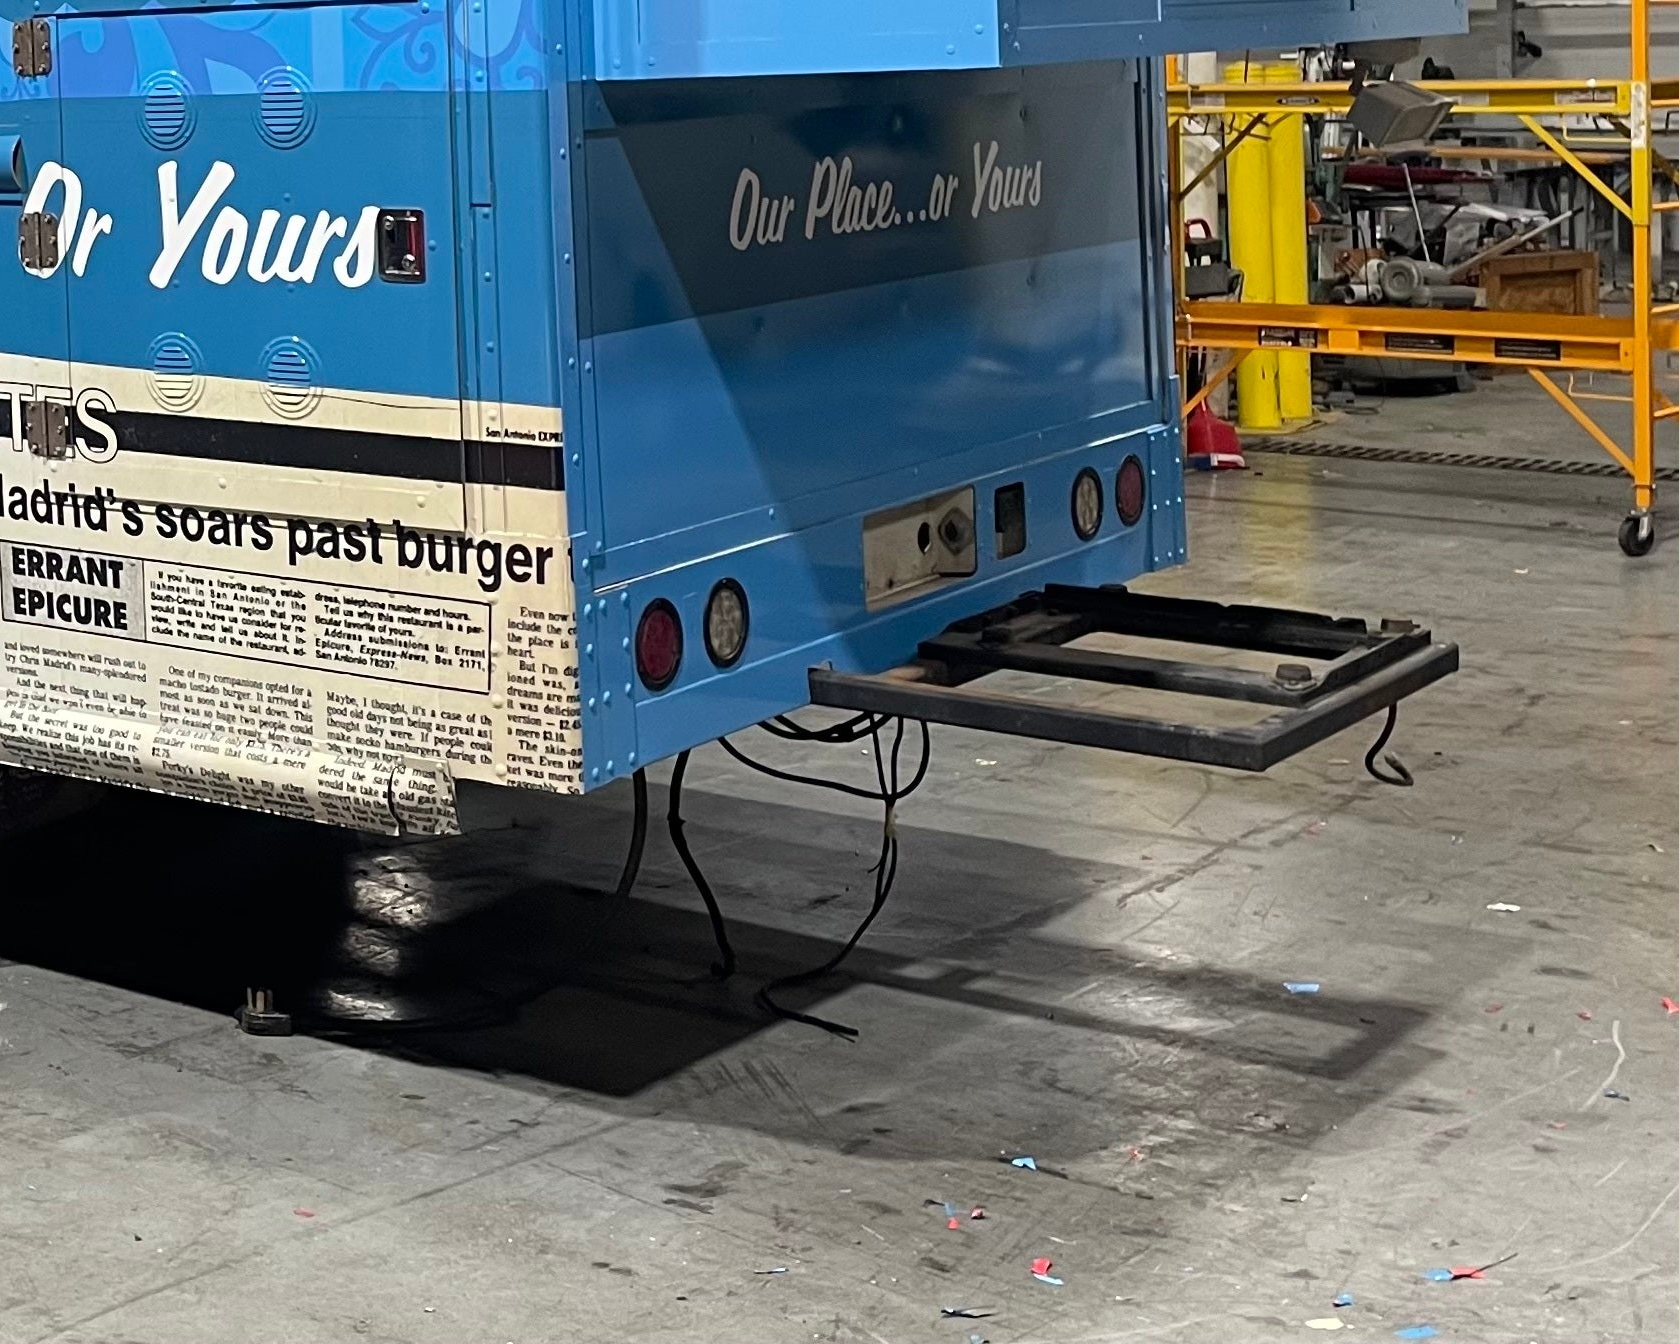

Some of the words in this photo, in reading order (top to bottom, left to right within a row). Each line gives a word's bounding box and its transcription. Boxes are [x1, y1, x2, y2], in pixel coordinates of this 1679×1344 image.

[730, 168, 794, 250] Our
[971, 141, 1042, 218] Yours
[18, 161, 114, 279] Or
[148, 159, 381, 288] Yours
[486, 426, 503, 439] San
[504, 427, 538, 442] Antonio
[156, 503, 273, 551] soars
[287, 516, 383, 567] past
[392, 518, 554, 592] burger
[12, 546, 123, 588] ERRANT
[167, 573, 182, 582] you
[186, 574, 204, 585] have
[13, 587, 128, 630] EPICURE
[196, 586, 204, 596] in
[210, 589, 228, 599] San
[233, 593, 270, 606] Antonio
[291, 601, 306, 611] the
[211, 600, 234, 612] Texas
[239, 606, 265, 617] region
[271, 609, 286, 619] that
[291, 614, 306, 623] you
[520, 606, 545, 620] Even
[548, 612, 569, 622] now
[507, 618, 542, 633] include
[547, 623, 562, 635] the
[324, 627, 362, 642] Address
[369, 634, 429, 651] submissions
[507, 632, 522, 644] the
[528, 636, 554, 649] place
[561, 639, 570, 649] is
[316, 649, 332, 661] San
[334, 652, 368, 666] Antonio
[435, 656, 453, 666] Box
[519, 660, 536, 673] But
[542, 664, 558, 676] I'm
[169, 666, 184, 676] One
[187, 670, 195, 678] of
[198, 672, 210, 683] my
[214, 674, 263, 689] companions
[292, 685, 303, 695] for
[327, 691, 358, 706] Maybe,
[441, 712, 461, 721] case
[467, 714, 476, 723] of
